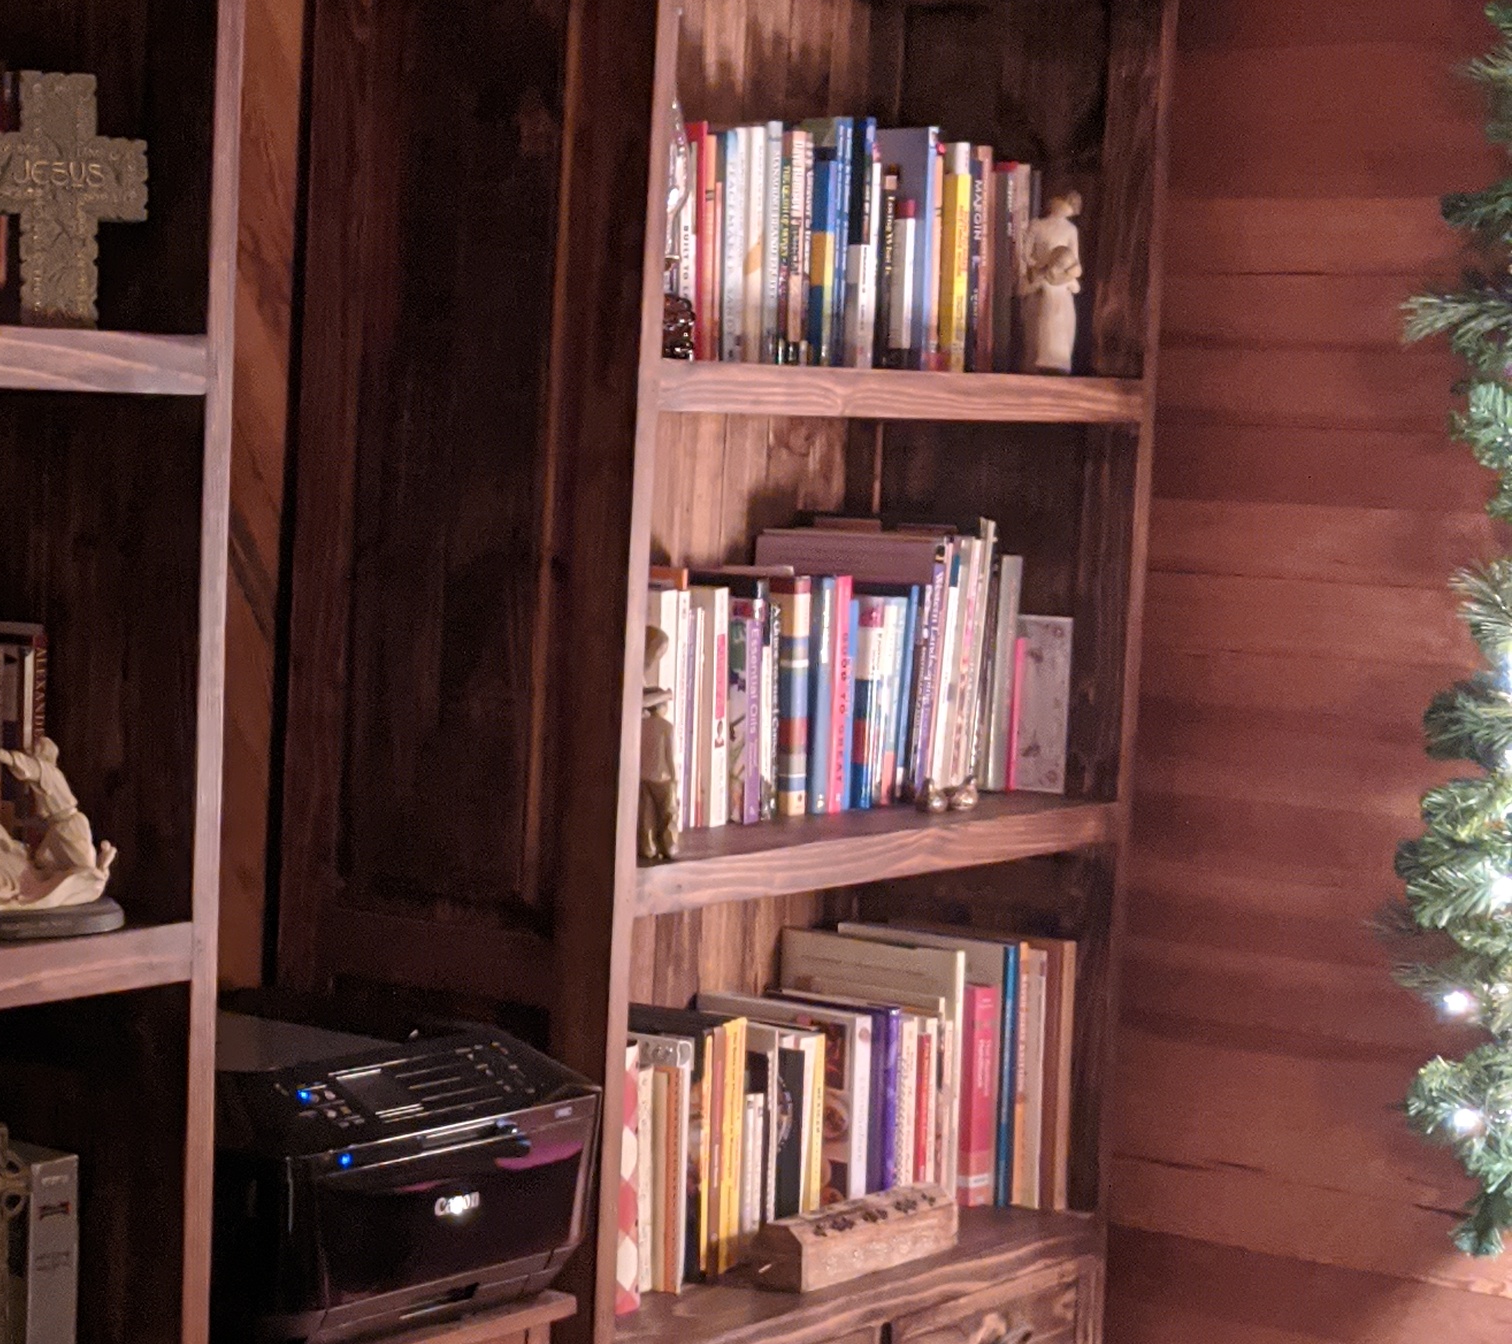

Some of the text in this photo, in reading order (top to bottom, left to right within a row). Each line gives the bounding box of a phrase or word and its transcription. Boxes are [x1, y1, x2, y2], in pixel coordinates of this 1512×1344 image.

[13, 158, 105, 189] JESUS
[792, 140, 804, 165] Dave
[769, 149, 782, 211] MANAGING
[769, 212, 781, 254] BRAND
[884, 195, 895, 232] Loving
[972, 179, 984, 242] MARGIN
[682, 224, 690, 281] BUILT TO
[885, 233, 895, 263] What
[748, 627, 760, 699] Essential
[922, 571, 945, 706] Western Landscaping
[33, 646, 49, 738] ALEXANDE
[835, 632, 850, 784] GOOD TO GREAT
[748, 703, 759, 734] Oils
[434, 1191, 481, 1217] Caon
